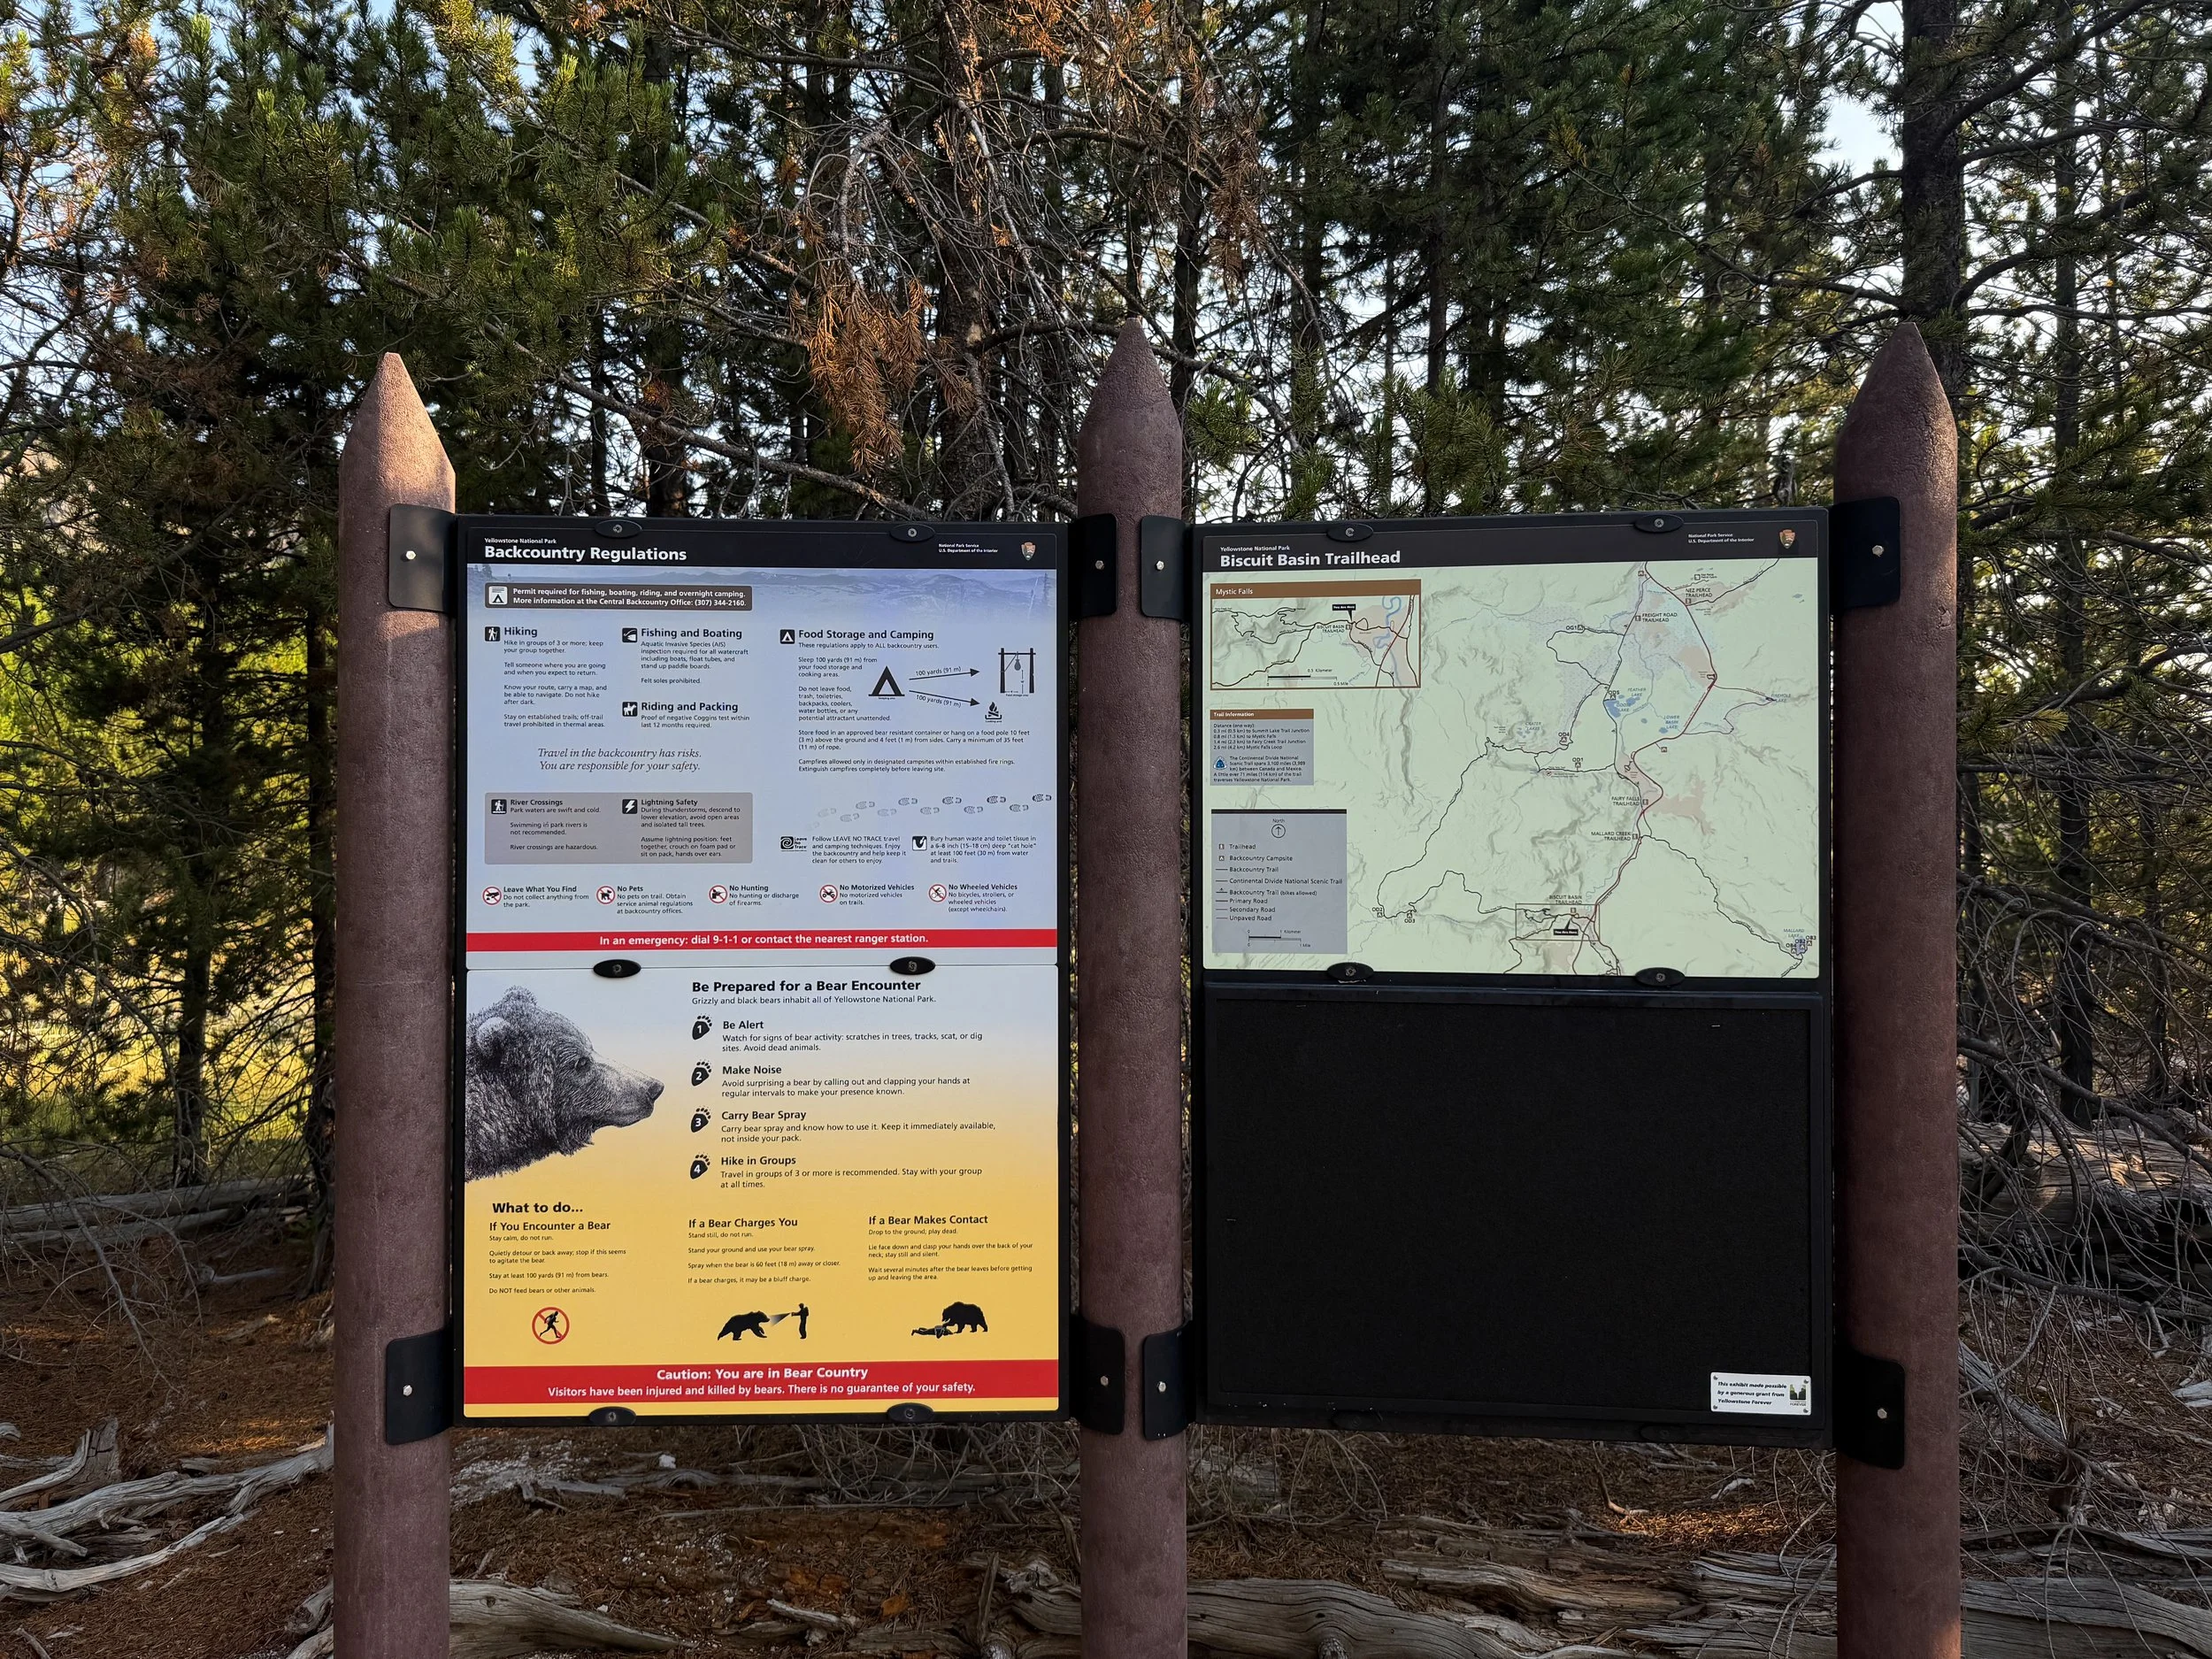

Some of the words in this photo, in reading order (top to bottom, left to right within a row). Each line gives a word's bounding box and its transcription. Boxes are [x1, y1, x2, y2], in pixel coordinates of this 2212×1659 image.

[485, 546, 586, 561] Backcountry
[591, 547, 687, 563] Regulations
[1221, 554, 1273, 567] Biscuit
[1279, 553, 1320, 565] Basin
[1325, 551, 1401, 565] Trailhead
[581, 588, 608, 597] fishing,
[504, 626, 538, 638] Hiking
[641, 628, 678, 639] Fishing
[680, 628, 700, 637] and
[703, 629, 742, 640] Boating
[826, 630, 865, 641] Storage
[868, 630, 887, 639] and
[890, 630, 933, 641] Camping
[641, 702, 674, 712] Riding
[677, 702, 696, 710] and
[700, 703, 738, 713] Packing
[570, 749, 580, 757] in
[581, 749, 596, 757] the
[598, 749, 657, 759] backcountry
[659, 749, 675, 757] has
[678, 749, 701, 757] risks.
[541, 761, 557, 770] You
[578, 761, 630, 772] responsible
[629, 761, 645, 772] for
[646, 764, 670, 772] your
[672, 761, 700, 772] safety.
[600, 936, 610, 945] In
[628, 938, 688, 947] emergency:
[691, 935, 710, 944] dial
[713, 935, 737, 944] 9-1-1
[795, 934, 812, 943] the
[855, 936, 888, 945] ranger
[891, 933, 928, 942] station.
[693, 982, 710, 992] Be
[714, 981, 775, 994] Prepared
[780, 980, 801, 991] for
[817, 980, 848, 991] Bear
[851, 980, 921, 990] Encounter
[739, 1020, 764, 1029] Alert
[723, 1065, 751, 1074] Make
[754, 1065, 782, 1074] Noise
[722, 1111, 749, 1122] Carry
[778, 1110, 806, 1121] Spray
[721, 1156, 744, 1165] Hike
[760, 1156, 796, 1166] Groups
[493, 1202, 529, 1213] What
[534, 1203, 549, 1213] to
[553, 1202, 583, 1212] do...
[490, 1222, 497, 1231] If
[500, 1222, 519, 1231] You
[523, 1222, 575, 1231] Encounter
[588, 1221, 611, 1230] Bear
[689, 1218, 696, 1228] If
[734, 1218, 775, 1229] Charges
[779, 1217, 798, 1226] You
[870, 1216, 877, 1225] If
[888, 1216, 911, 1225] Bear
[657, 1369, 711, 1379] Caution:
[716, 1369, 740, 1379] You
[768, 1368, 780, 1379] in
[784, 1368, 813, 1378] Bear
[817, 1367, 868, 1379] Country
[549, 1386, 587, 1396] Visitors
[590, 1386, 615, 1396] have
[618, 1386, 643, 1395] been
[646, 1386, 682, 1397] injured
[685, 1386, 704, 1394] and
[708, 1385, 735, 1394] killed
[739, 1385, 751, 1396] by
[754, 1385, 785, 1394] bears.
[787, 1384, 817, 1394] There
[820, 1384, 827, 1393] is
[847, 1385, 899, 1394] guarantee
[902, 1382, 913, 1392] of
[916, 1385, 940, 1394] your
[942, 1382, 975, 1394] safety.
